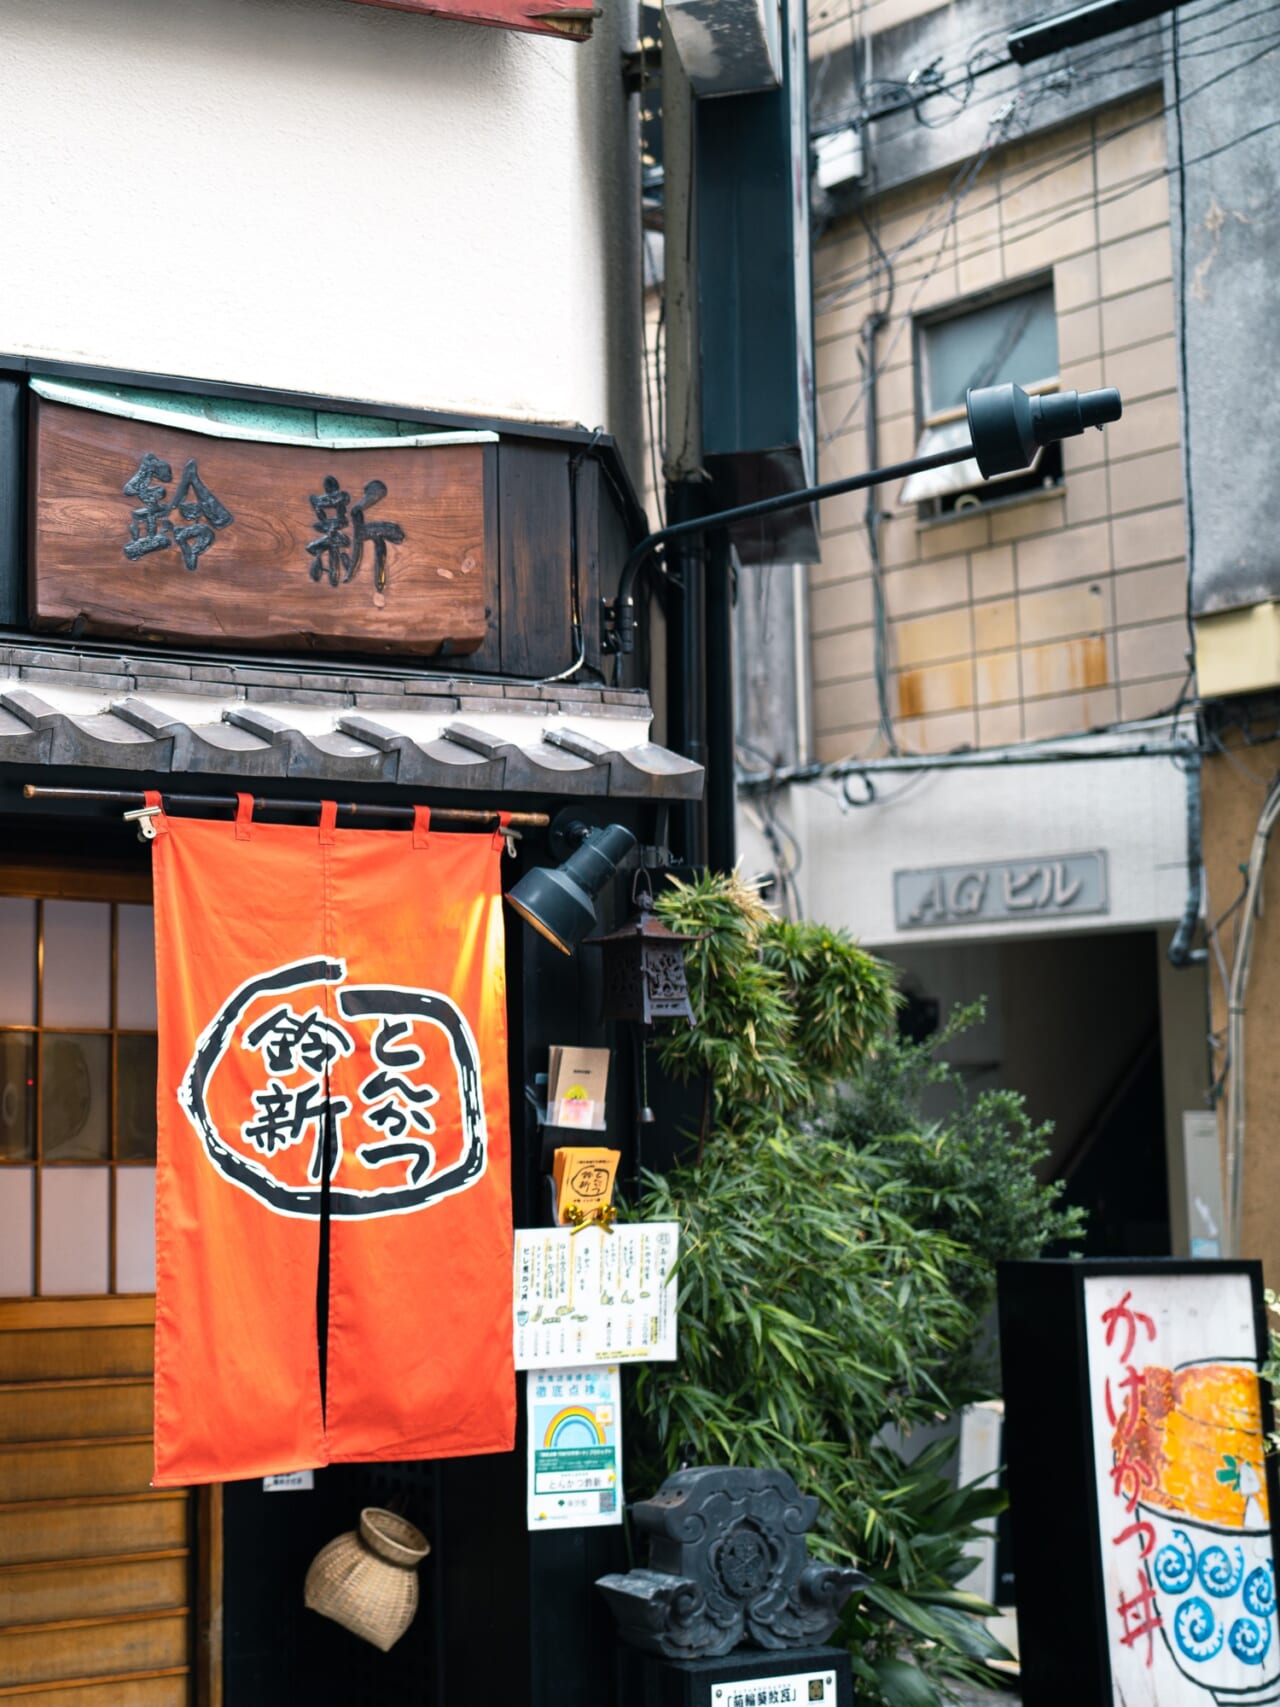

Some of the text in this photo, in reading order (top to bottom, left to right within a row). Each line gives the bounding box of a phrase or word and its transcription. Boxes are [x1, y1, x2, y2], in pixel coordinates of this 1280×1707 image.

[124, 452, 406, 594] 鈴新
[909, 862, 1084, 922] AG ビル
[245, 1008, 351, 1180] 鈴新
[359, 1017, 435, 1186] とんかつ
[1101, 1291, 1163, 1668] かけかつ丼
